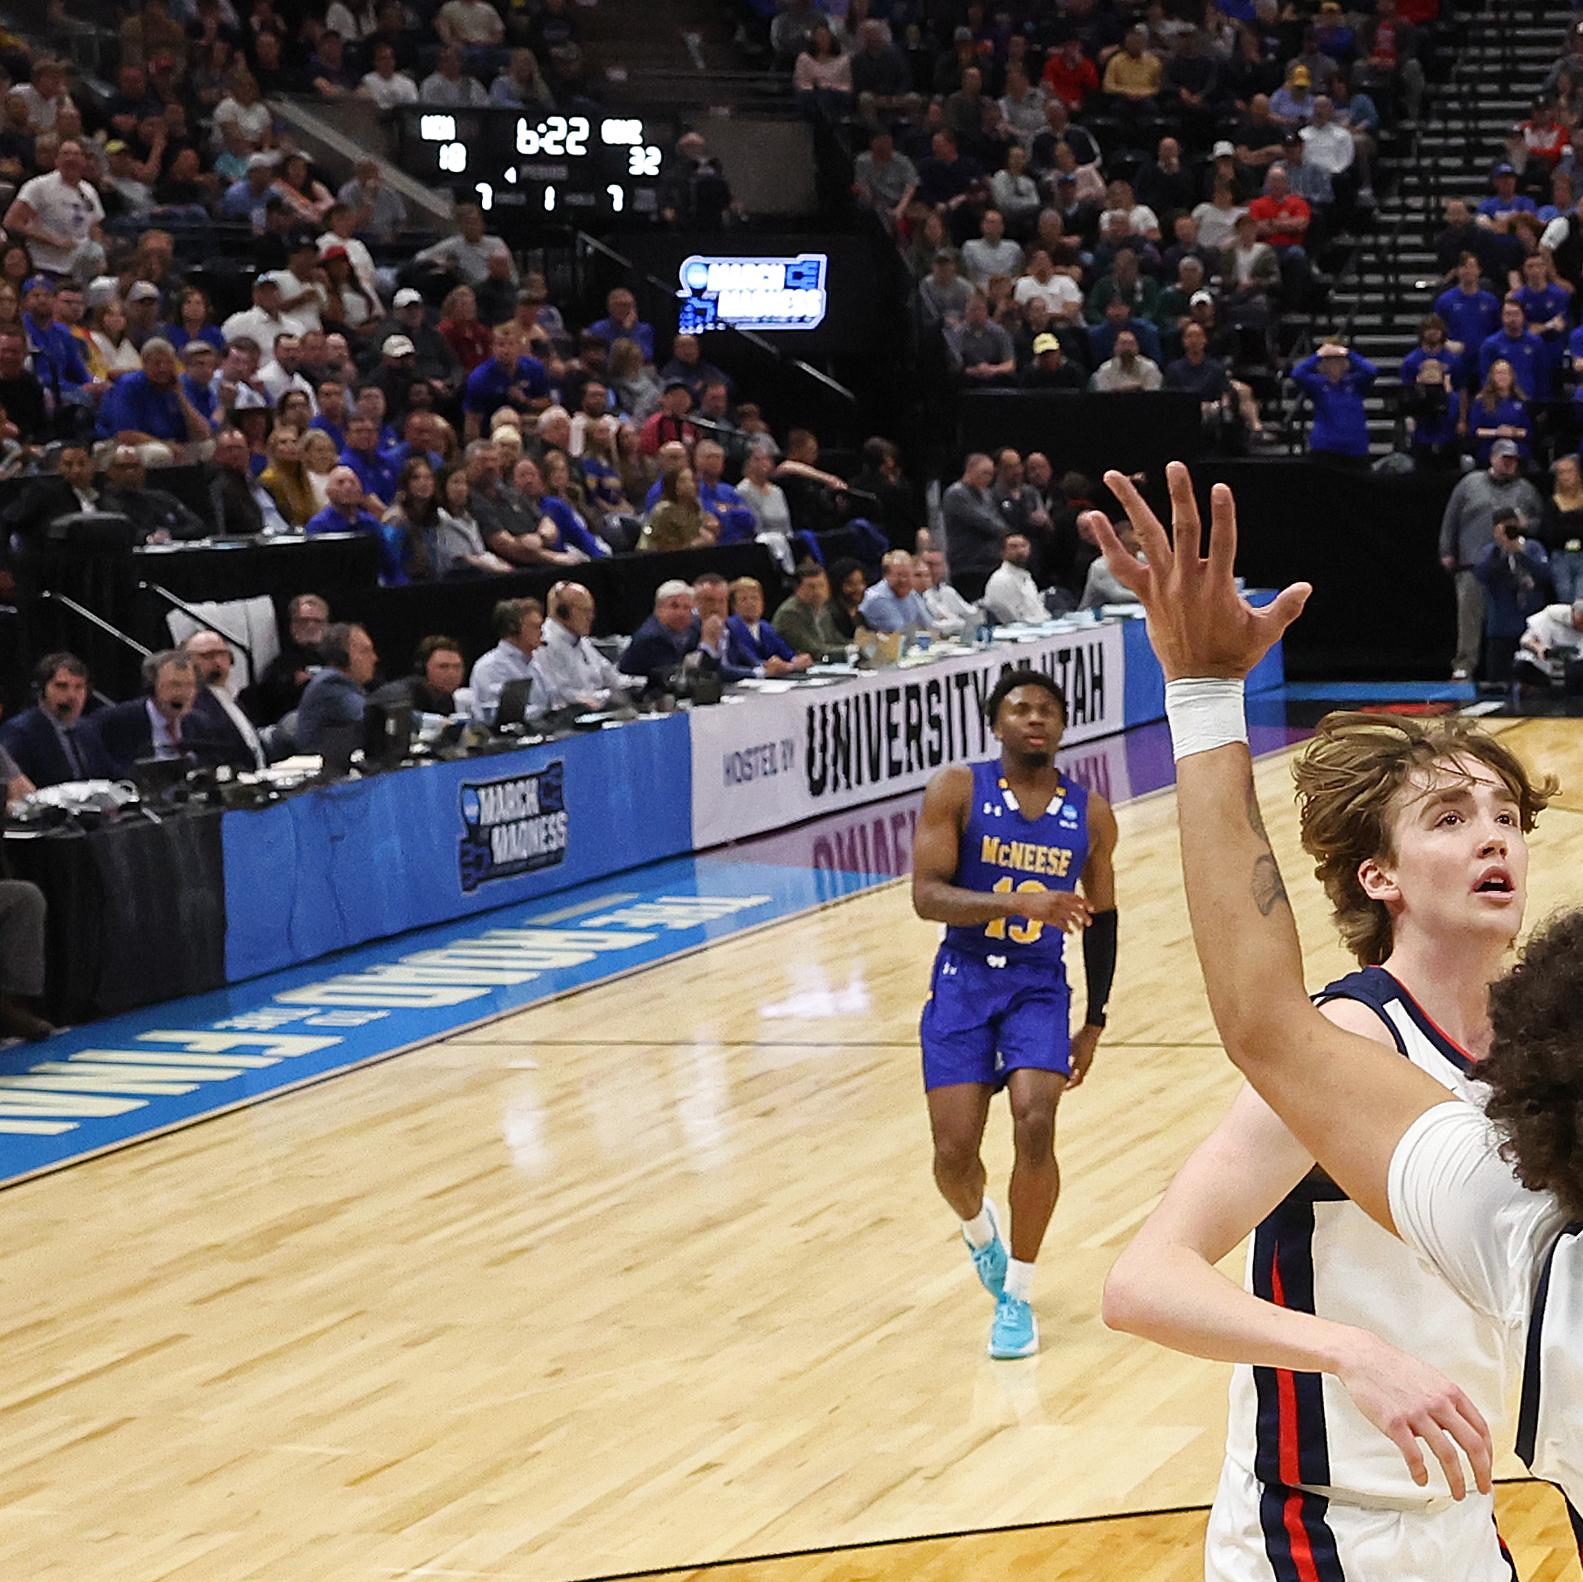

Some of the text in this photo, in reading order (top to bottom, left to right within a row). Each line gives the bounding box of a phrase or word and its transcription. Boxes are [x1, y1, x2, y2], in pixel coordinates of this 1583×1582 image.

[516, 116, 590, 155] 6:22
[807, 667, 990, 797] UNIVERSITY
[478, 777, 541, 826] MARCH
[491, 810, 569, 865] MADNESS
[981, 834, 1073, 878] McNEESE
